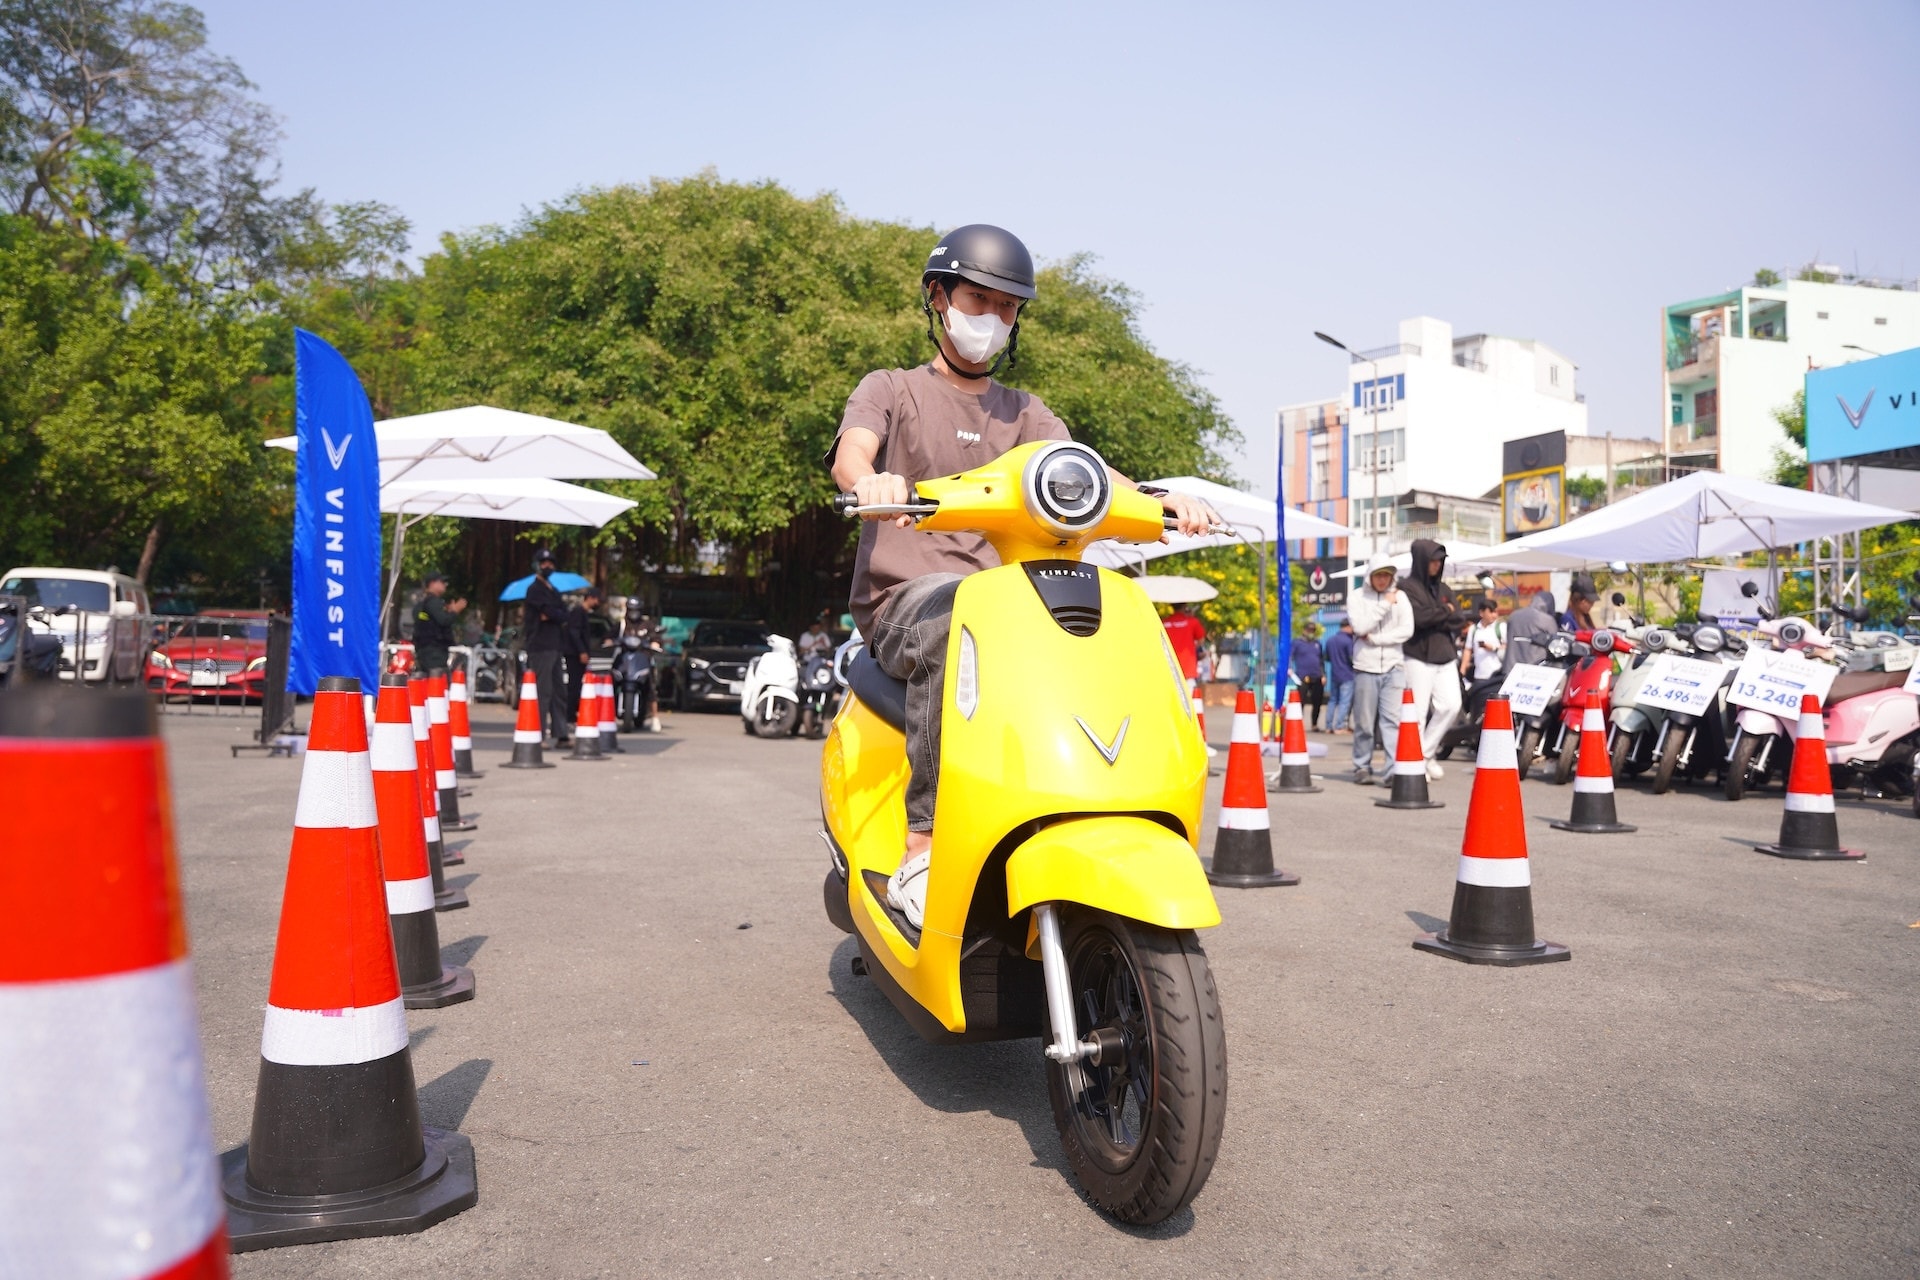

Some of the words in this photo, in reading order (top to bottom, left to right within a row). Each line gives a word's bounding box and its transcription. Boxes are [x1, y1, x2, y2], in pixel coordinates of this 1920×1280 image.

[957, 430, 980, 441] PAPA
[325, 487, 344, 648] VINFAST
[1039, 569, 1092, 580] VINFAST
[1642, 684, 1690, 703] 26.496
[1738, 682, 1798, 708] 13.248
